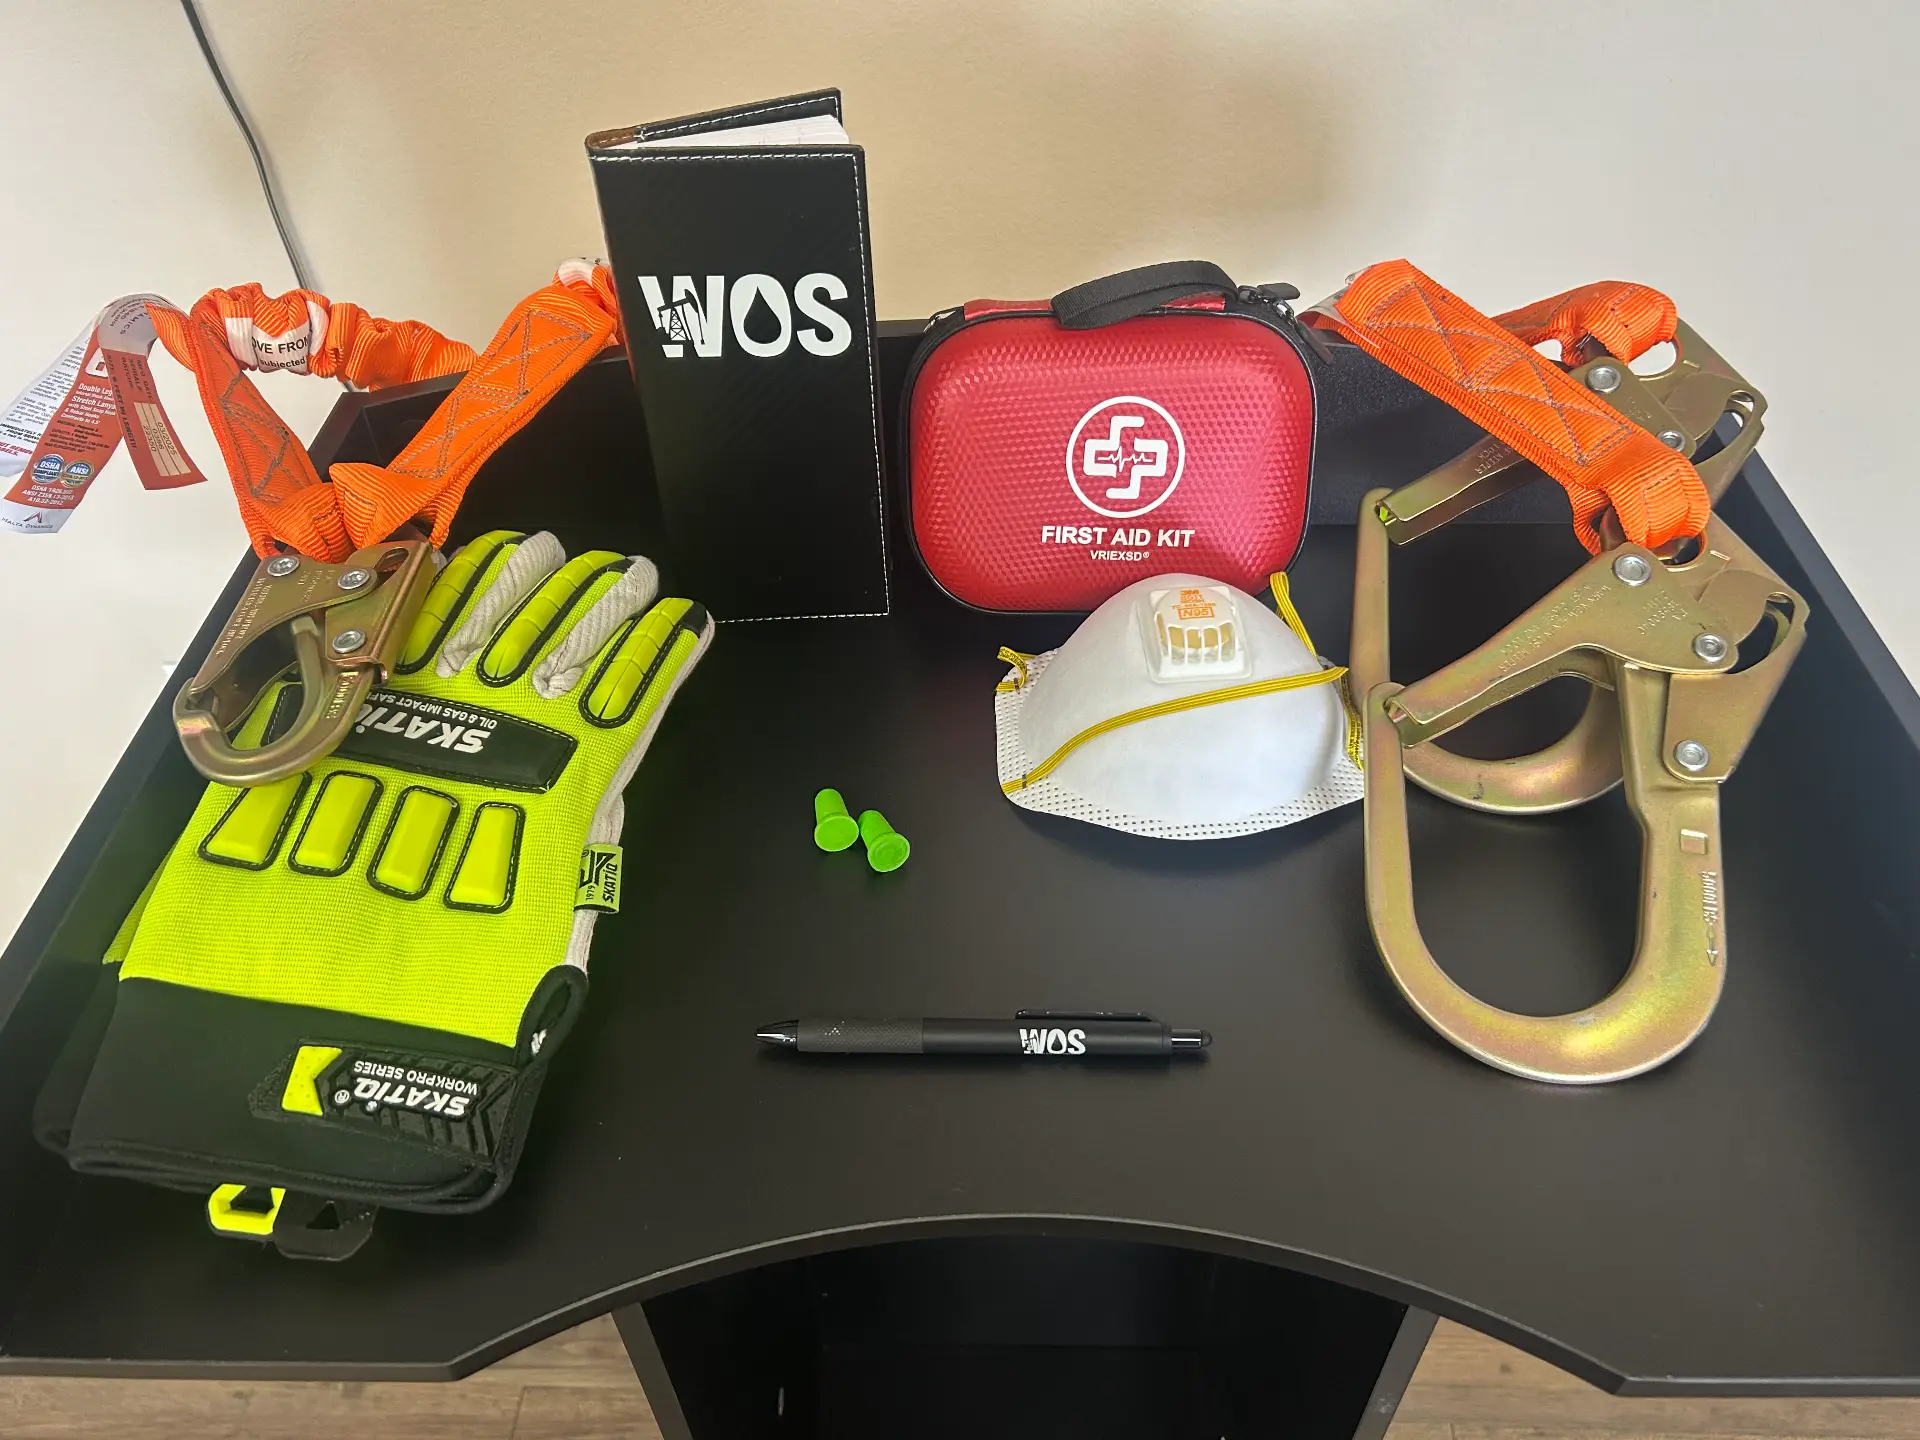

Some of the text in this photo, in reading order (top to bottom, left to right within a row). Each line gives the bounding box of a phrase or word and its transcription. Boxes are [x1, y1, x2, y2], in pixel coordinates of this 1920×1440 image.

[637, 272, 852, 358] WOS
[79, 383, 101, 392] Double
[72, 395, 96, 406] Stretch
[157, 421, 178, 455] 03/2025
[40, 460, 60, 470] OSHA
[70, 466, 89, 475] ANSI
[1041, 526, 1195, 548] FIRST AID KIT
[396, 696, 442, 714] IMPACT
[443, 708, 467, 720] GAS
[468, 716, 477, 724] &
[479, 718, 497, 731] OIL
[585, 885, 596, 900] 1979
[1019, 1028, 1086, 1055] WOS
[353, 1060, 478, 1096] WORKPRO SERIES
